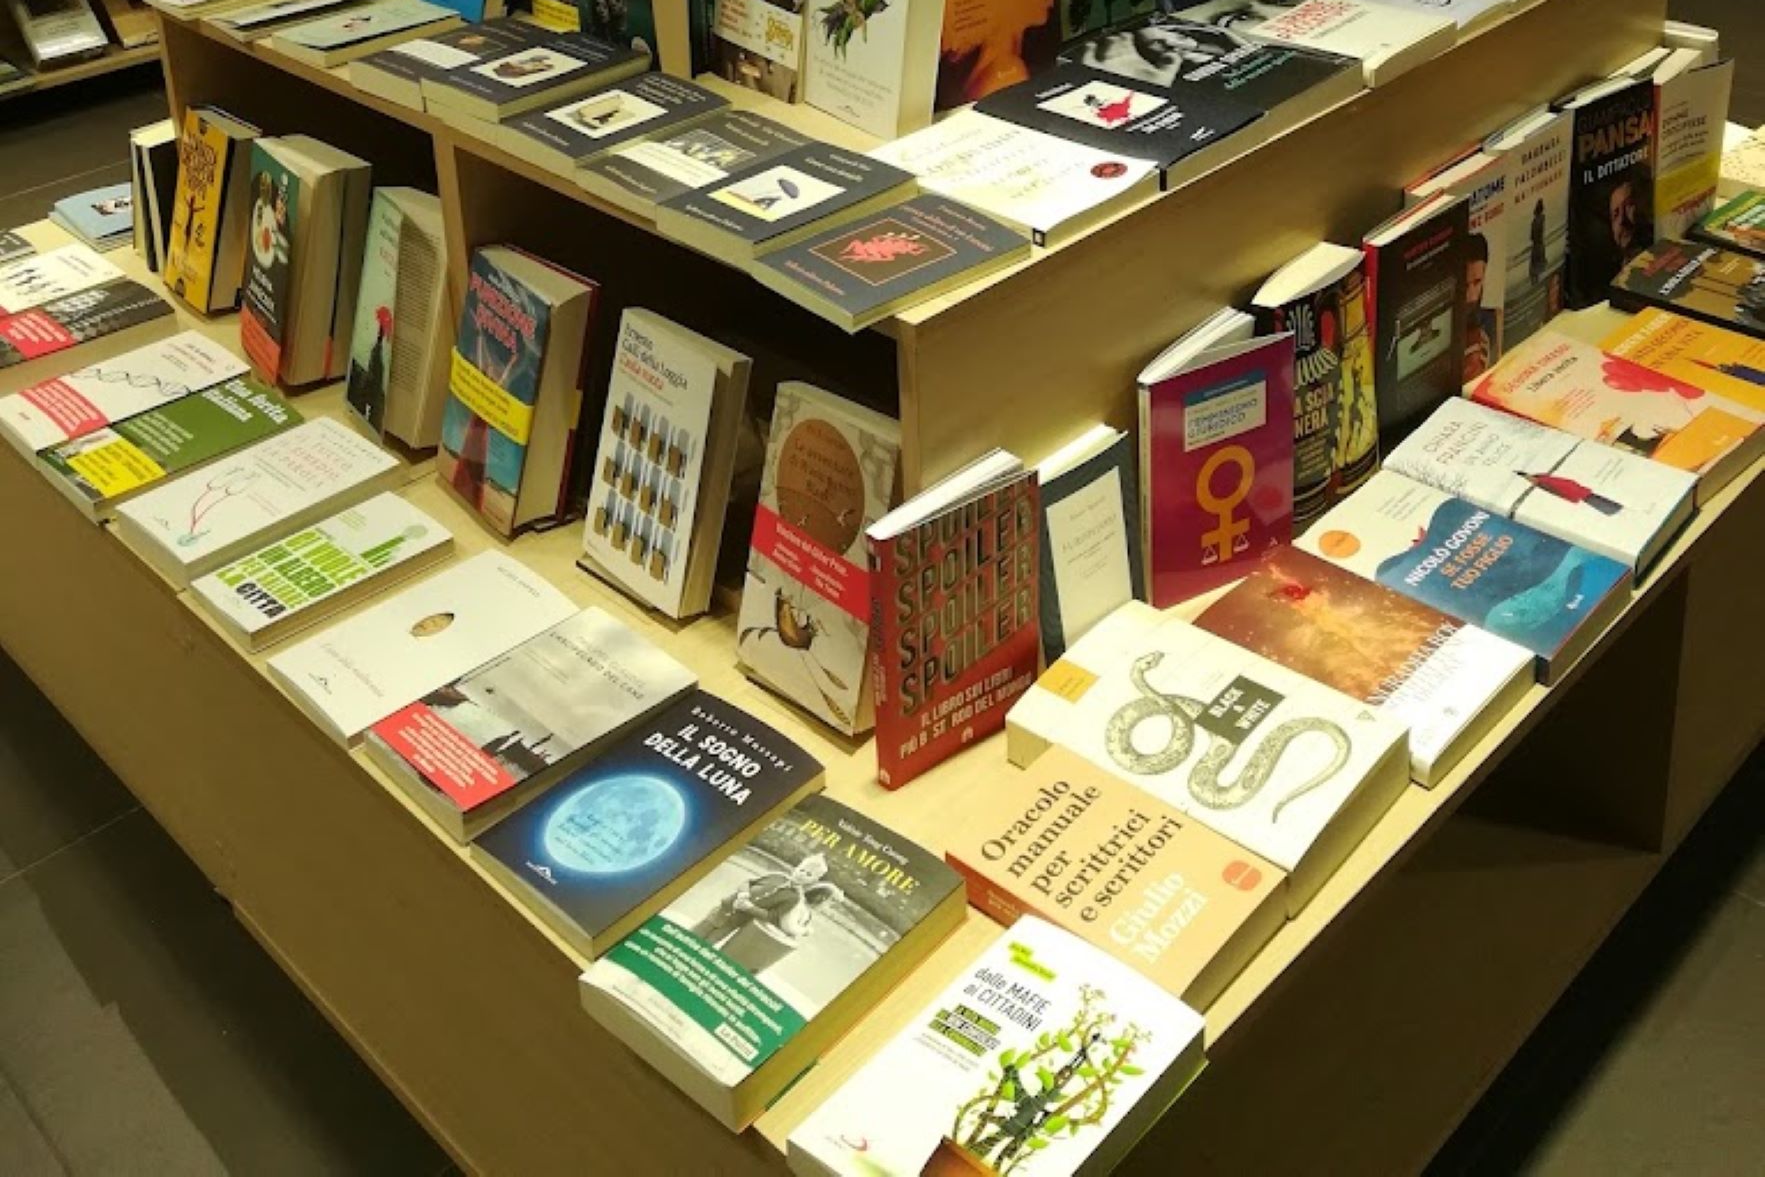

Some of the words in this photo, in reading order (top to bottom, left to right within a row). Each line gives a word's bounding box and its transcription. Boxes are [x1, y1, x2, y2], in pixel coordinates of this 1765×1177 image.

[1578, 110, 1650, 162] PANSA
[1470, 174, 1506, 205] ATOME
[1583, 170, 1595, 185] IL
[1295, 406, 1329, 439] NERA
[896, 493, 1034, 627] SPOILER
[1404, 545, 1452, 587] NICOLÒ
[1446, 510, 1491, 550] GOVONI
[1439, 561, 1457, 580] SE
[1450, 567, 1478, 592] TUO
[1477, 534, 1515, 573] FIGLIO
[897, 539, 1034, 672] SPOILER
[899, 586, 1034, 719] SPOILER
[690, 705, 738, 738] Roberto
[932, 691, 965, 721] LIBRO
[974, 692, 995, 715] DEL
[1208, 686, 1244, 719] BLACK
[1235, 698, 1272, 731] WHITE
[644, 731, 696, 772] DELLA
[696, 762, 753, 808] LUNA
[676, 722, 698, 744] IL
[697, 736, 763, 780] SOGNO
[981, 778, 1071, 862] Oracolo
[1006, 783, 1102, 879] manuale
[802, 818, 844, 849] PER
[846, 841, 922, 894] AMORE
[1030, 848, 1071, 896] per
[1055, 808, 1153, 909] scrittrici
[1079, 905, 1099, 924] e
[1095, 814, 1185, 905] scrittori
[1109, 871, 1186, 947] Giulio
[1129, 885, 1209, 966] Mozzi
[974, 988, 1045, 1032] CITTADINI
[975, 967, 1010, 995] dalle
[1009, 981, 1053, 1017] MAFIE
